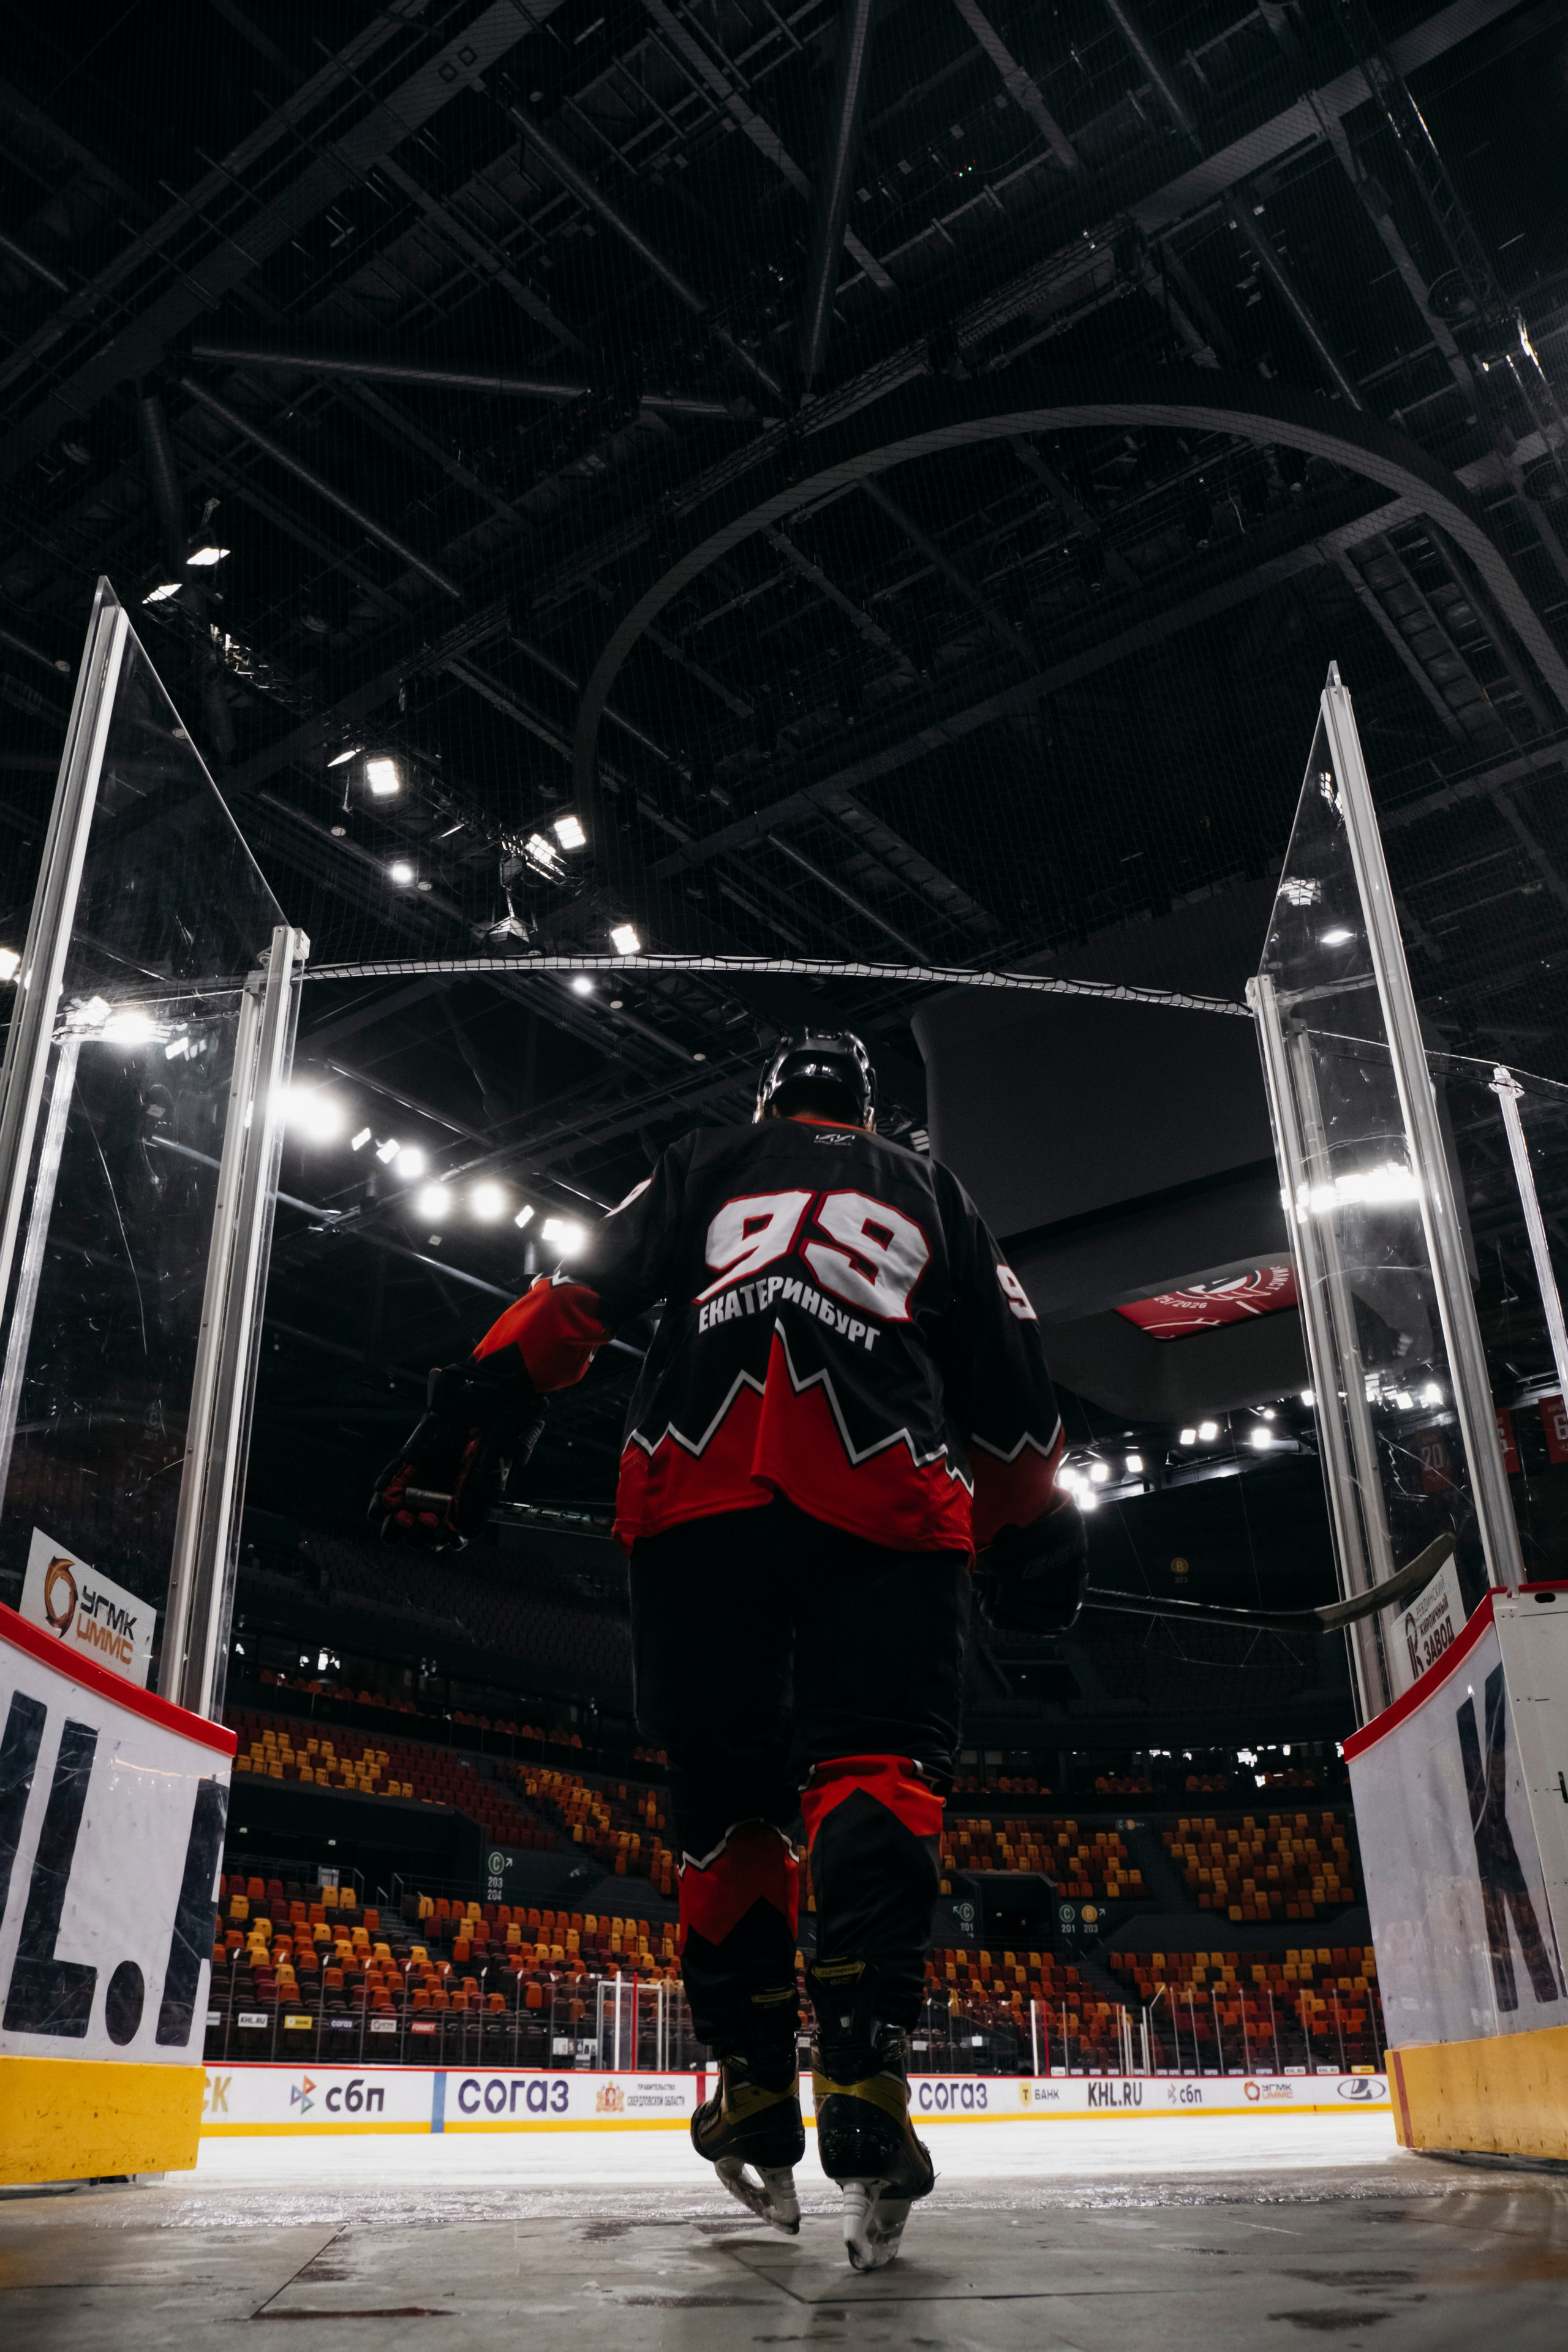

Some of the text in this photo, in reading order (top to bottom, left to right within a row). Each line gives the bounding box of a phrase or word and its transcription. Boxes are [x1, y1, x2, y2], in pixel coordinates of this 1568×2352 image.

[692, 1188, 932, 1322] 99
[698, 1276, 881, 1352] ЕКАТЕРИНБУРГ
[80, 1585, 138, 1641] УГМК
[1420, 1594, 1449, 1637] КИРПИЧНЫЙ
[76, 1613, 134, 1665] UMMC
[1424, 1615, 1455, 1667] ЗАВОД
[488, 1876, 503, 1888] 203
[1061, 1924, 1076, 1933] 201
[1035, 2089, 1060, 2100] БАНК
[1088, 2082, 1142, 2106] KHL.RU
